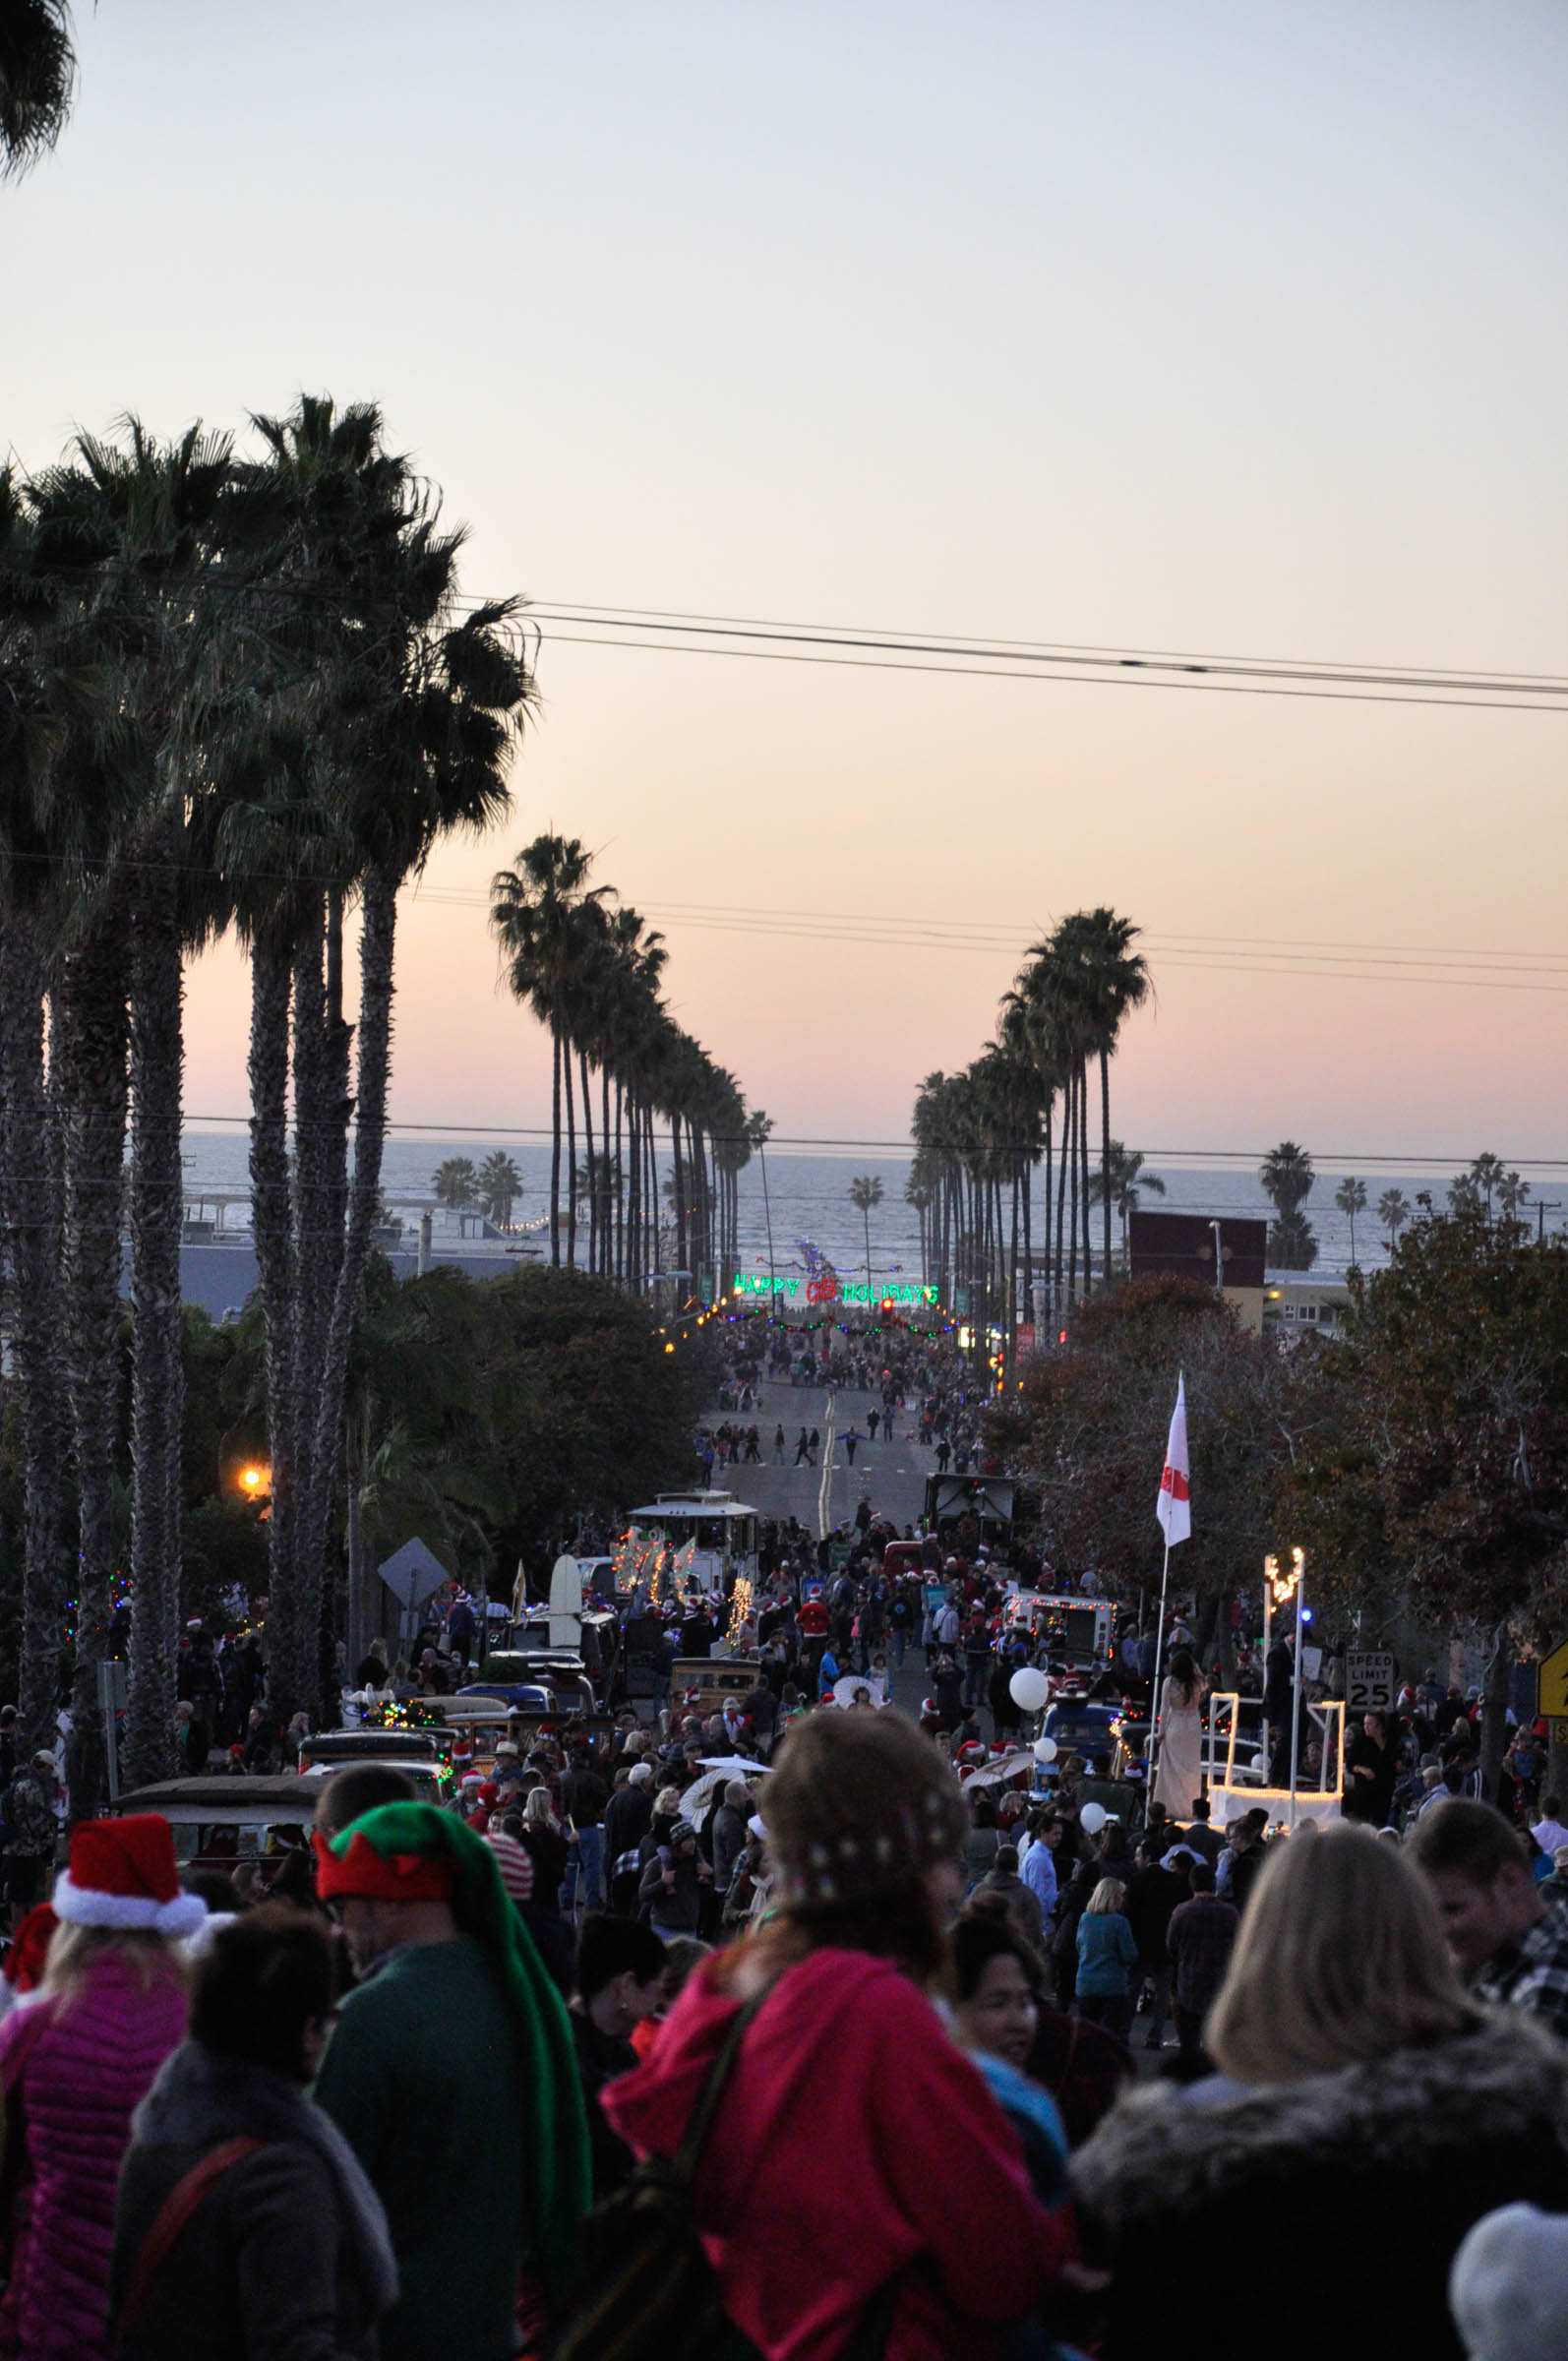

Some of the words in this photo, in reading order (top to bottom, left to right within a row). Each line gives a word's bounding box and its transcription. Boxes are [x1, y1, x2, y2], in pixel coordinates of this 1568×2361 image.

[734, 1274, 799, 1297] HAPPY
[842, 1282, 938, 1304] HOLIDAYS
[1348, 1655, 1392, 1666] SPEED
[1352, 1669, 1388, 1680] LIMIT
[1351, 1683, 1389, 1706] 25
